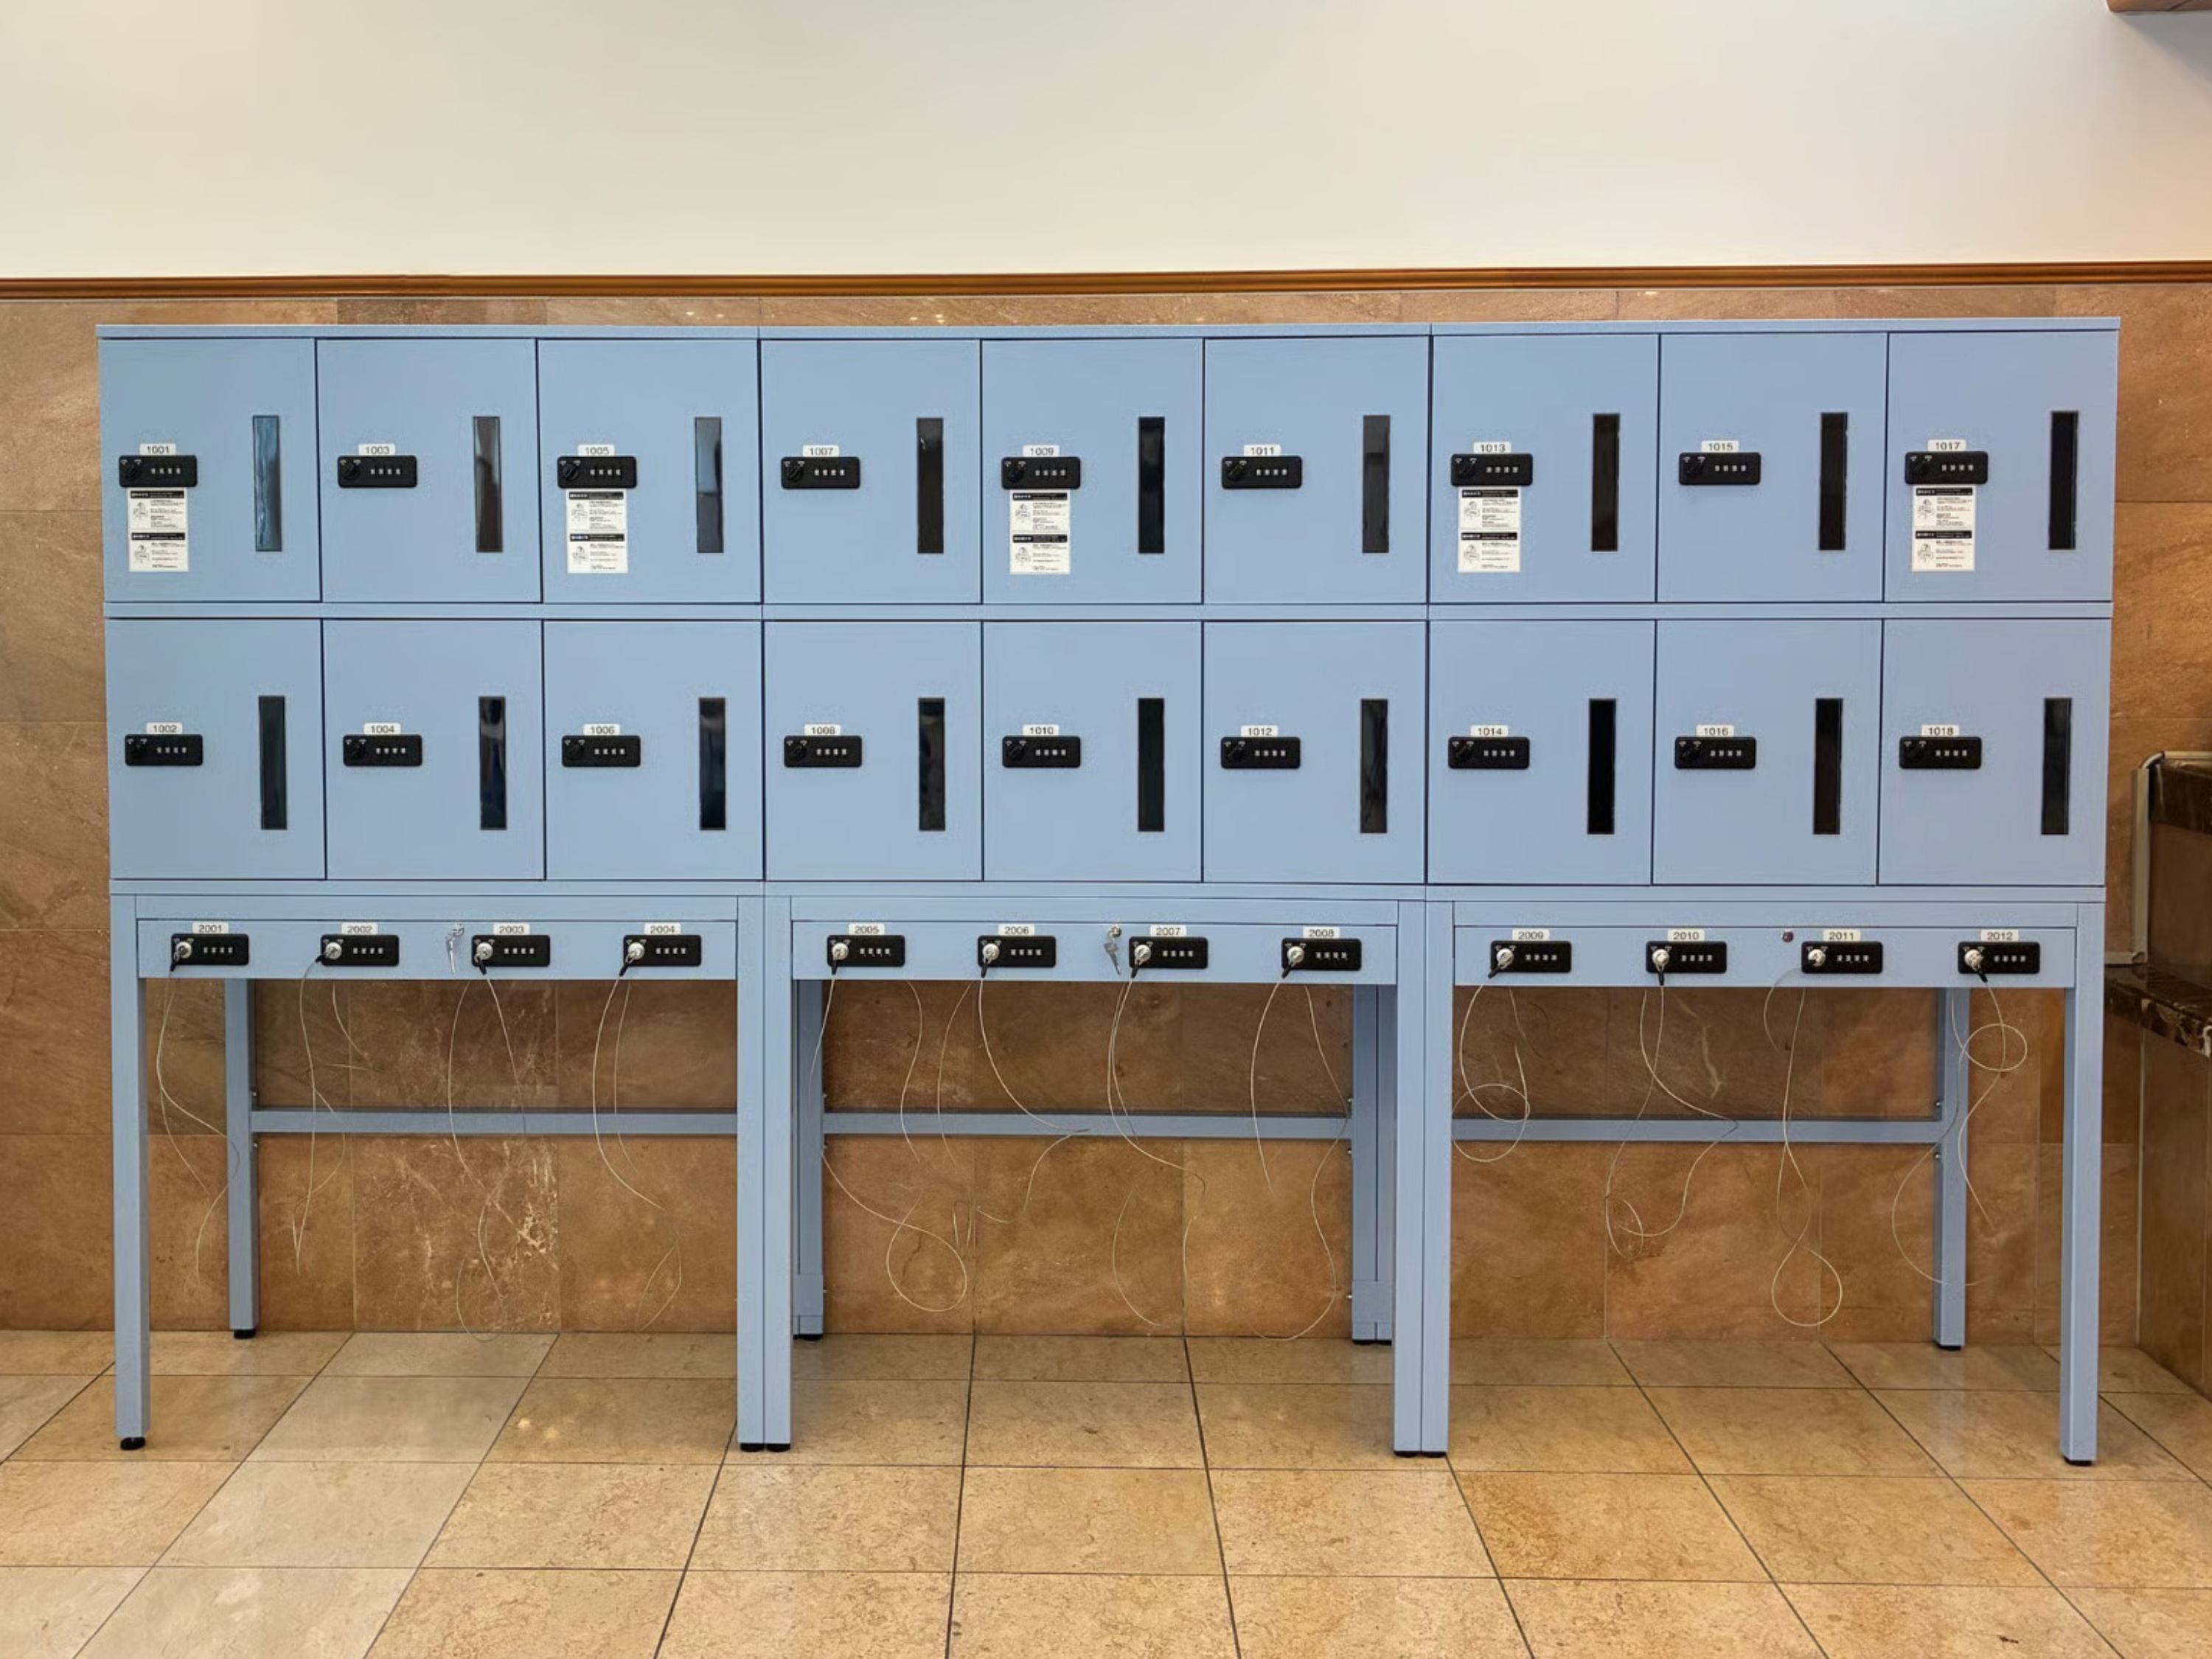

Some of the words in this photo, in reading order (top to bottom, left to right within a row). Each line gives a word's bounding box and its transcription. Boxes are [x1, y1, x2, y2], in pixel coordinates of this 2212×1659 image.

[147, 446, 170, 454] 1001
[365, 446, 390, 455] 1003
[1481, 444, 1506, 453] 1013
[1708, 442, 1733, 451] 1015
[1935, 442, 1961, 451] 1017
[585, 447, 610, 455] 1005
[810, 448, 834, 456] 1007
[1251, 447, 1275, 455] 1011
[153, 725, 177, 733] 1002
[371, 726, 395, 734] 1004
[1029, 726, 1054, 734] 1010
[1248, 728, 1273, 736] 1012
[1478, 728, 1503, 736] 1014
[198, 925, 223, 933] 2001
[347, 925, 372, 934] 2002
[650, 925, 675, 933] 2004
[1156, 928, 1180, 936] 2007
[1673, 932, 1700, 940] 2010
[1829, 931, 1854, 940] 2011
[1987, 932, 2013, 940] 2012
